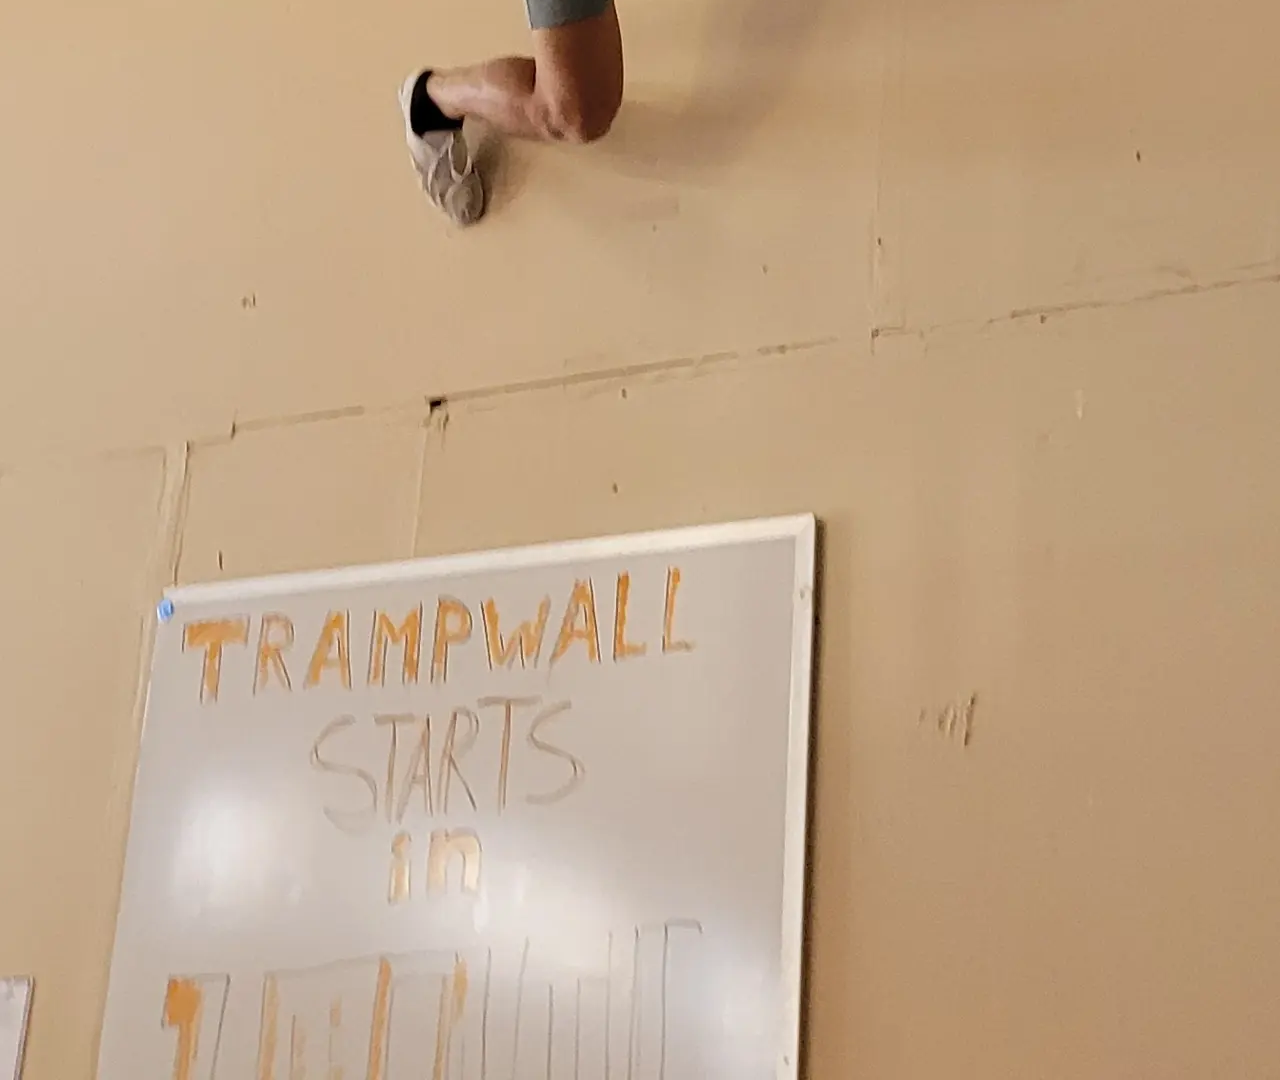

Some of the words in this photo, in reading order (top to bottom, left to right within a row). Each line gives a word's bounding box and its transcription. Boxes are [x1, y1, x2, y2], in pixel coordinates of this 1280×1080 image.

[181, 564, 697, 705] TRAMPWALL
[310, 694, 585, 833] STARTS
[386, 827, 484, 906] in
